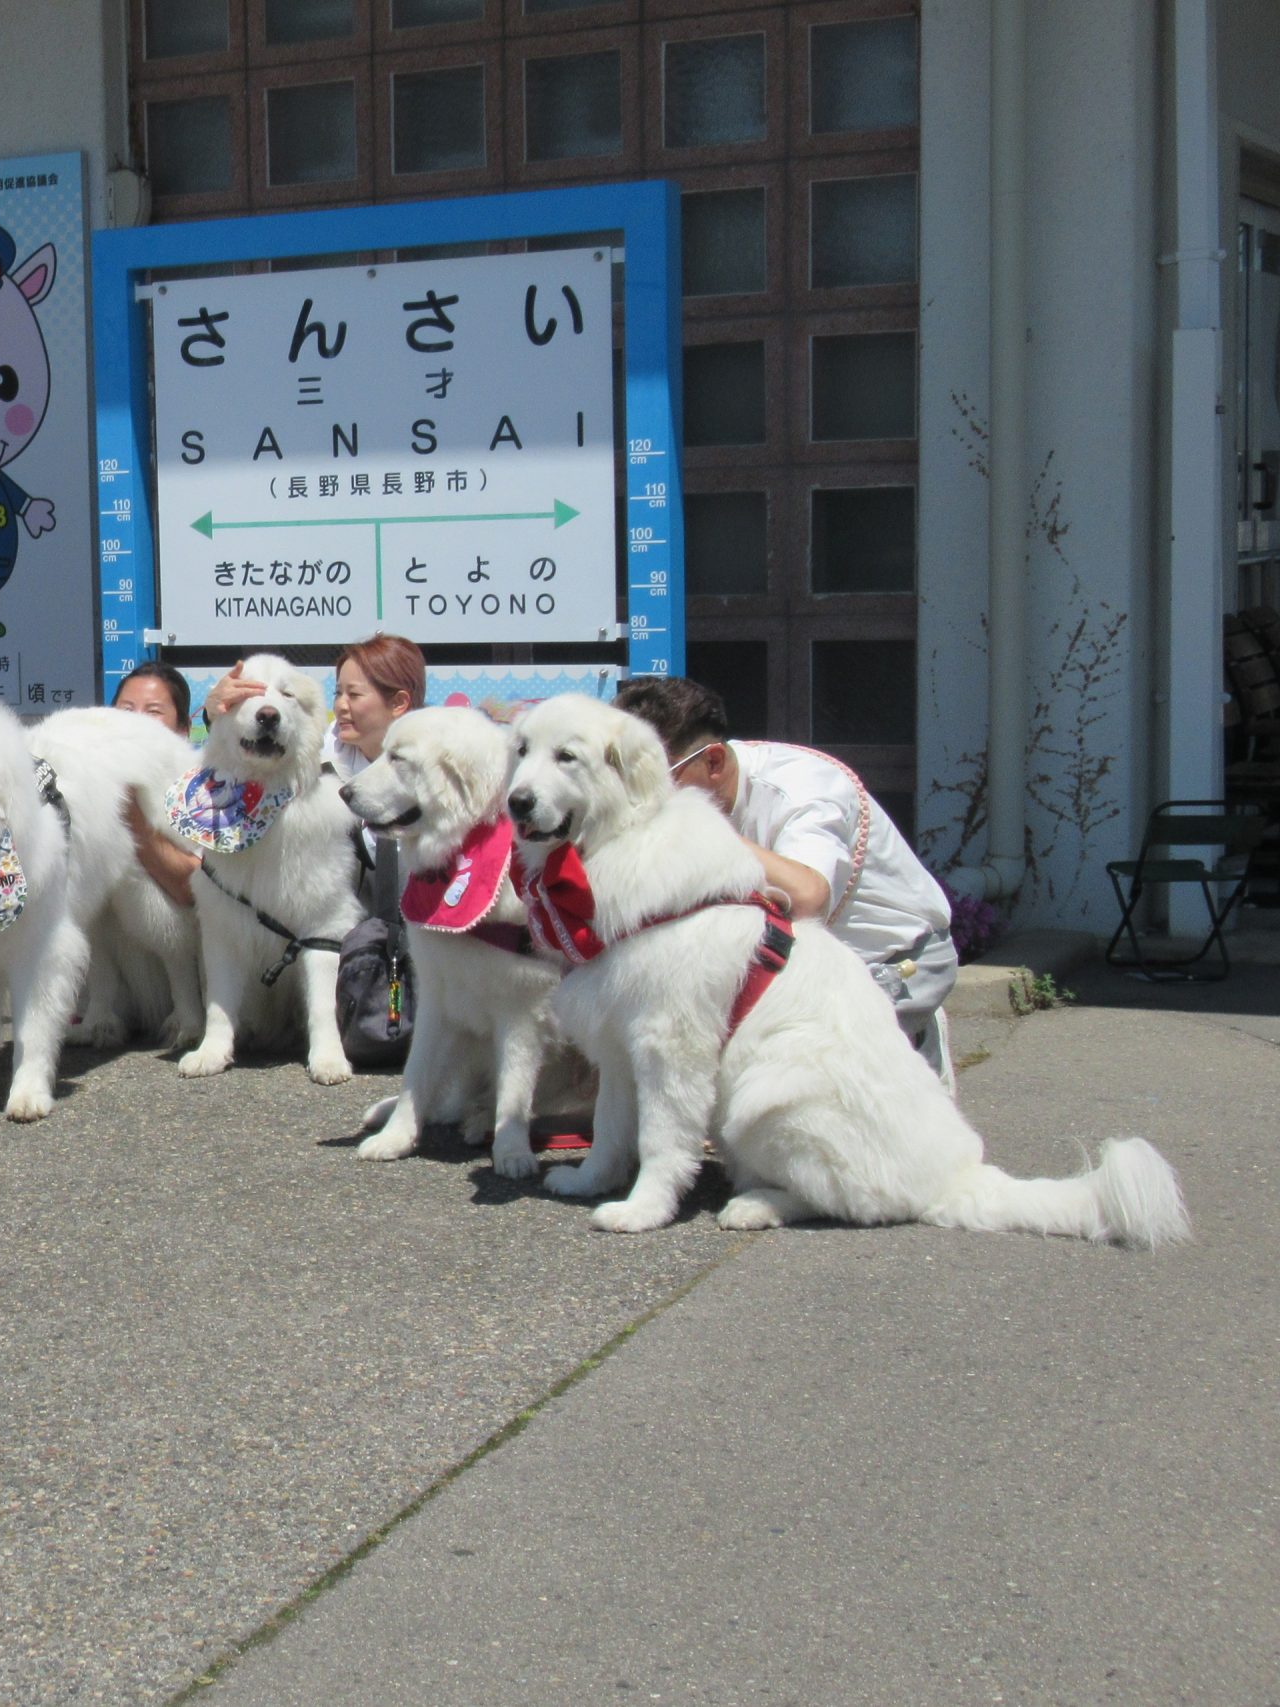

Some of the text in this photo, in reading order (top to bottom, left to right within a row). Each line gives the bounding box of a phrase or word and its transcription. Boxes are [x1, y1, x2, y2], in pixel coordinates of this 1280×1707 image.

[177, 285, 584, 367] さんさい
[296, 366, 455, 405] 三才
[180, 411, 585, 465] SANSAI
[629, 439, 651, 451] 120
[99, 459, 118, 471] 120
[269, 468, 489, 499] （長野県長野市）
[644, 483, 666, 495] 110
[112, 499, 131, 511] 110
[629, 527, 652, 540] 100
[101, 539, 120, 551] 100
[214, 559, 352, 586] きたながの
[404, 555, 557, 584] とよの
[650, 571, 667, 583] 90
[118, 578, 133, 591] 90
[214, 595, 352, 618] KITANAGANO
[404, 593, 557, 617] TOYONO
[104, 619, 117, 631] 80
[631, 616, 647, 628] 80
[121, 659, 135, 671] 70
[651, 659, 667, 672] 70
